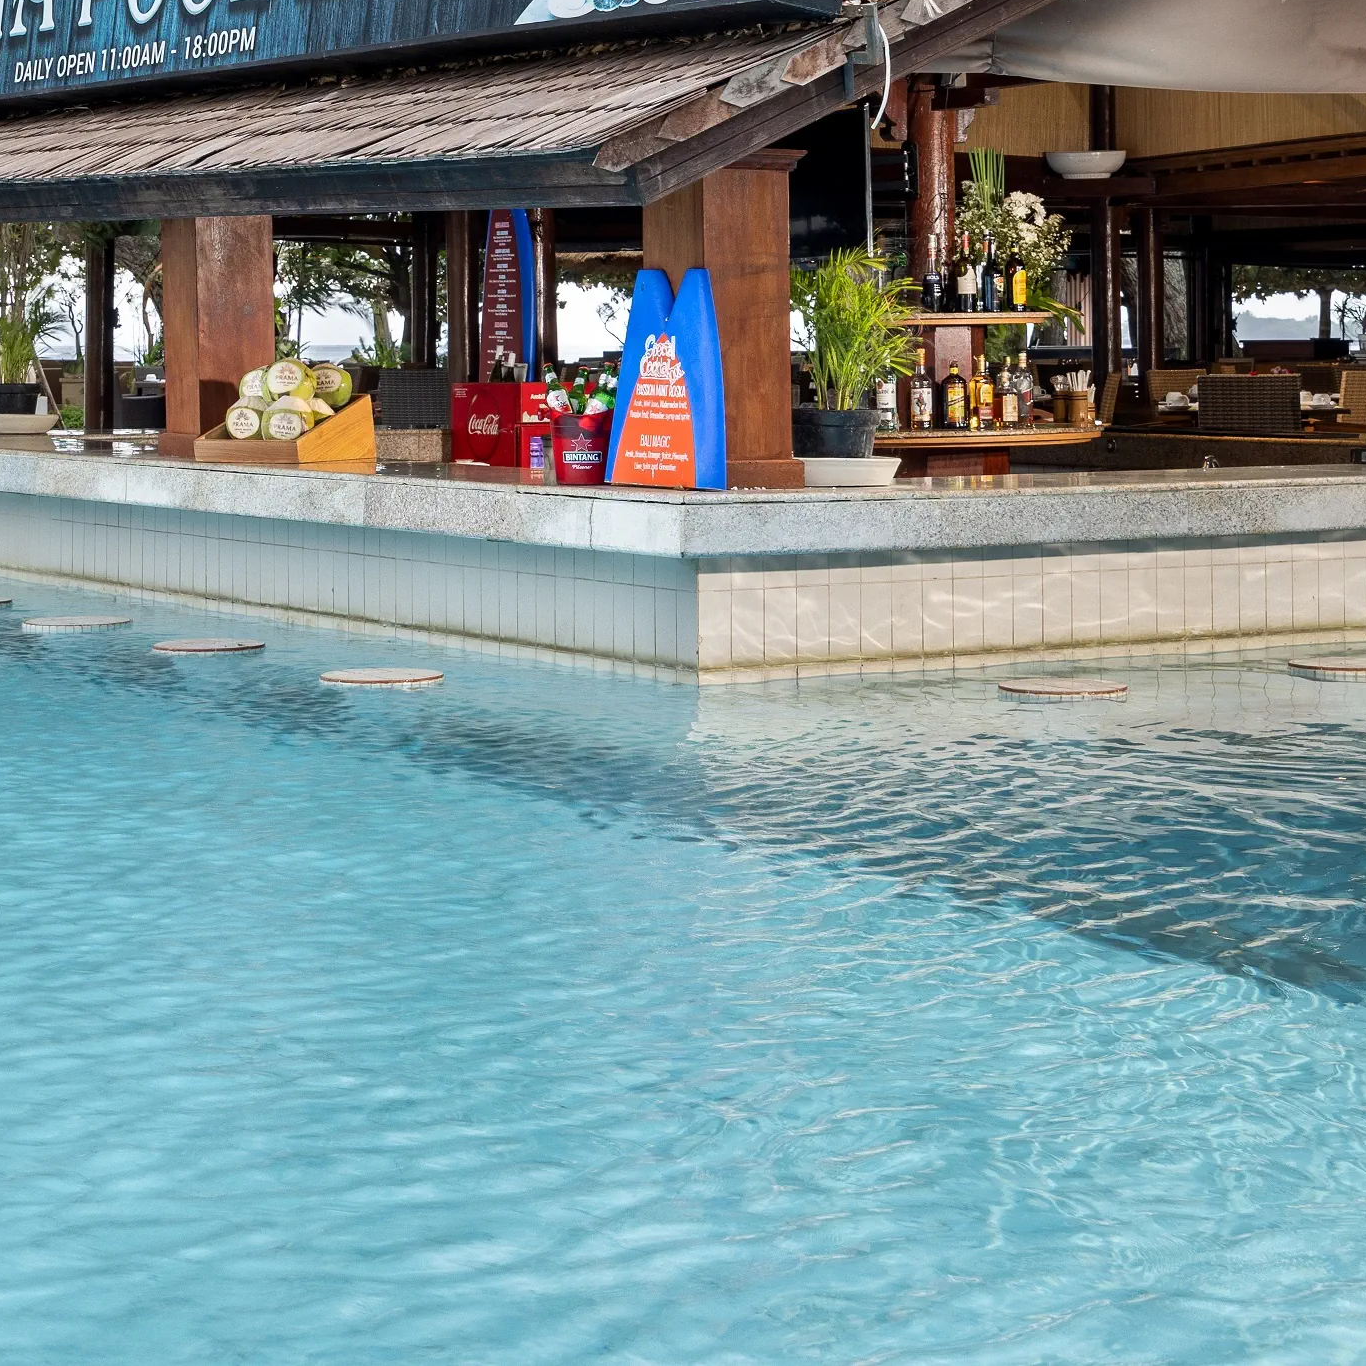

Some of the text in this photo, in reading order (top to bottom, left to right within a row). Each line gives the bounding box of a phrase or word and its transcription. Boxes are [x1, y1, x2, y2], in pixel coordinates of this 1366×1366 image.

[14, 57, 54, 83] DAILY
[56, 51, 95, 77] OPEN
[101, 40, 166, 71] 11:00AM
[184, 26, 257, 60] 18:00PM
[274, 424, 296, 432] PRAMA
[640, 434, 670, 447] BALI MAGIC
